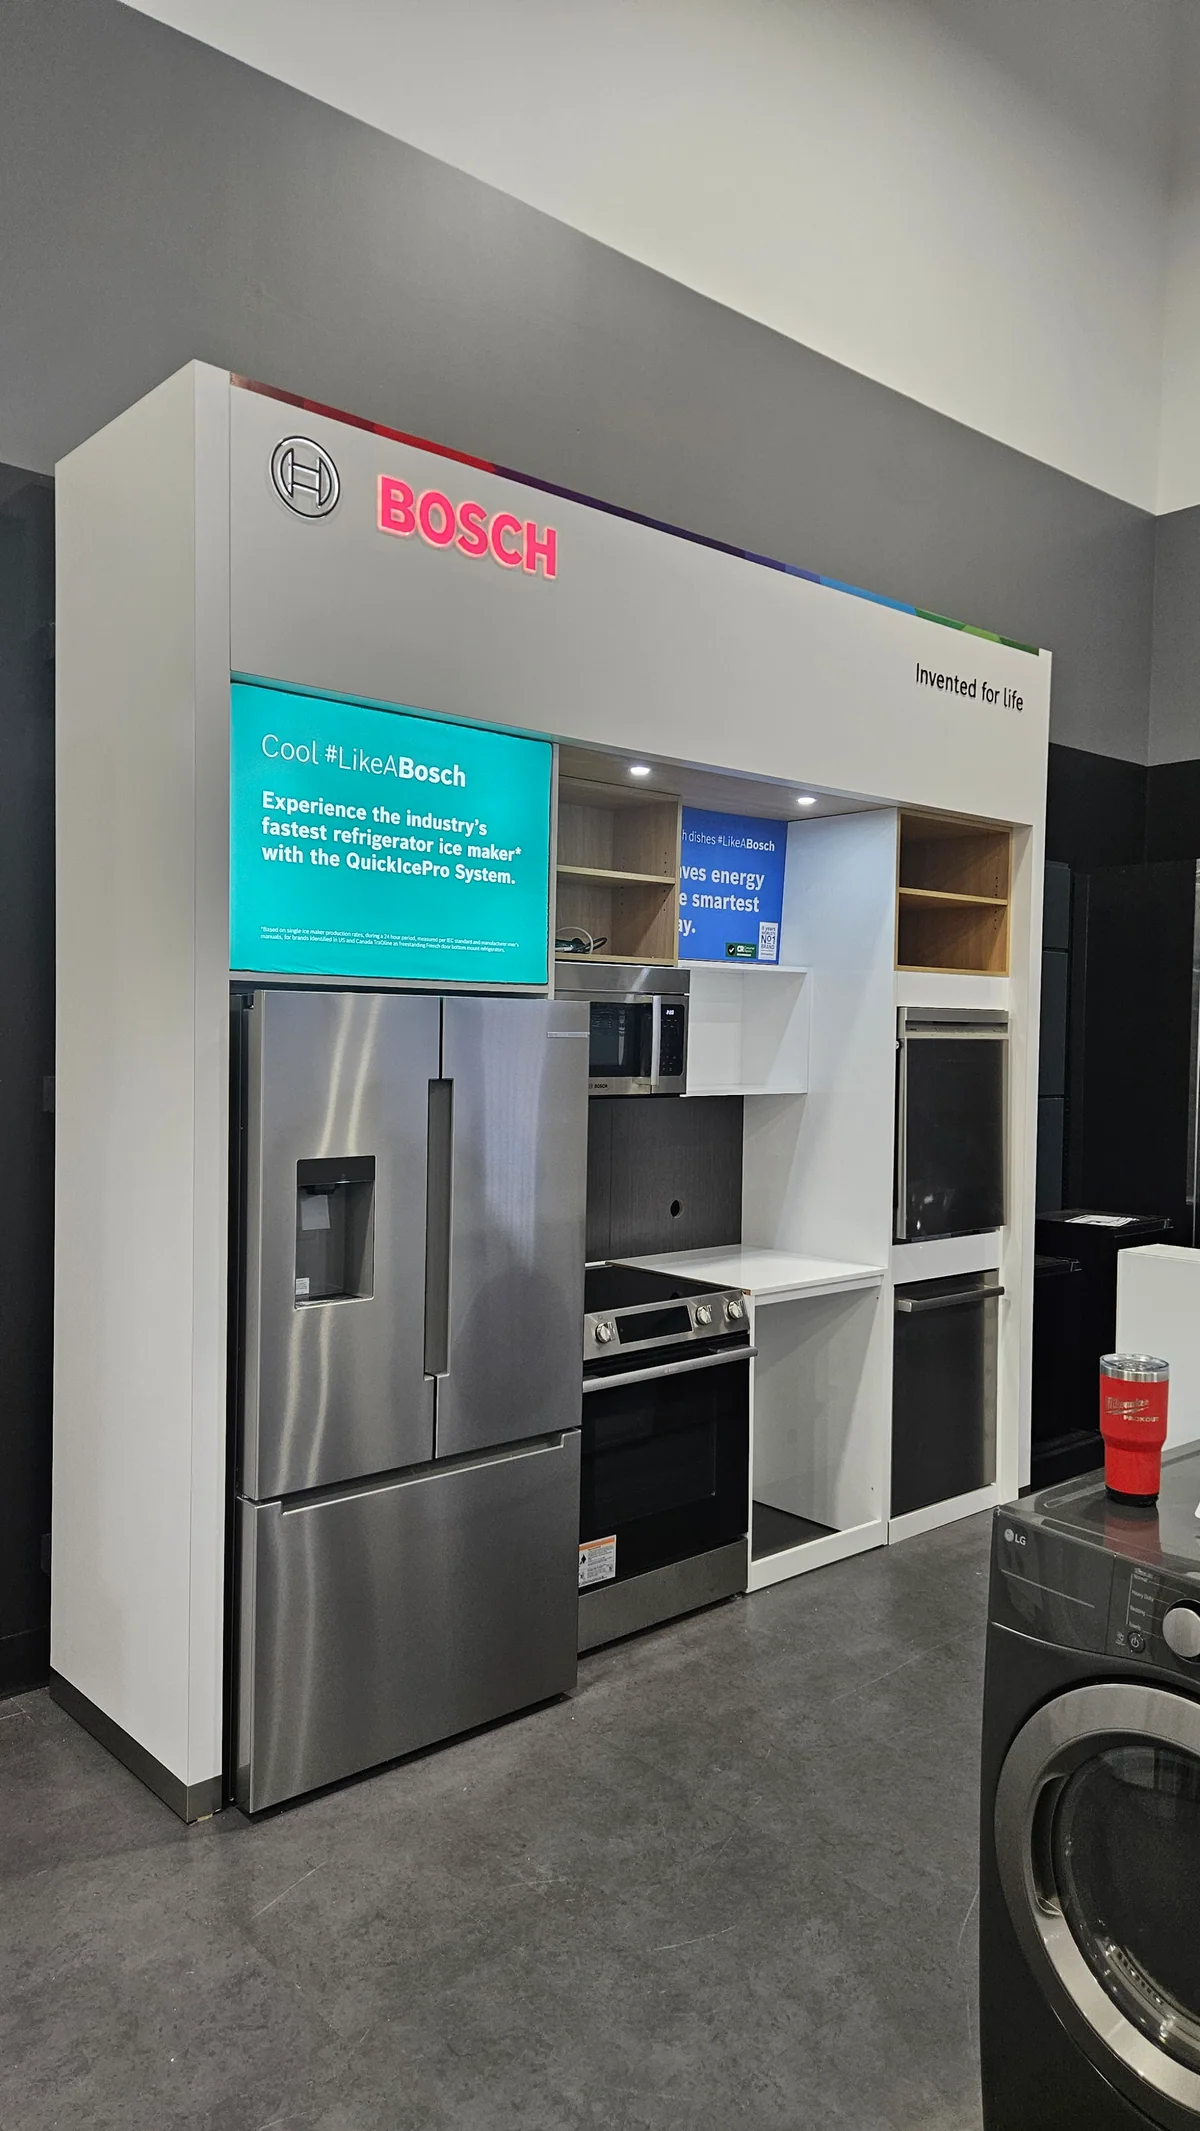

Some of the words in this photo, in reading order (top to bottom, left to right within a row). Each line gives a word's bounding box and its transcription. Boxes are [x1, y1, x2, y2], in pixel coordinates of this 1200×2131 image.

[377, 474, 558, 581] BOSCH
[916, 662, 977, 698] Invented
[981, 682, 1000, 704] for
[1003, 687, 1024, 711] life
[261, 733, 318, 765] Cool
[324, 743, 466, 788] #LikeABosch
[262, 790, 367, 821] Experience
[372, 805, 401, 825] the
[406, 809, 488, 837] industry's
[261, 816, 327, 841] fastest
[333, 826, 434, 853] refrigerator
[438, 837, 462, 856] ice
[689, 831, 716, 846] dishes
[717, 836, 775, 852] #LikeABosch
[261, 843, 304, 864] with
[309, 847, 340, 867] the
[346, 851, 450, 879] QuickIcePro
[454, 863, 516, 885] System.
[680, 865, 706, 882] ves
[711, 870, 765, 891] energy
[692, 893, 760, 913] smartest
[286, 926, 301, 936] single
[310, 928, 325, 936] maker
[325, 930, 351, 938] production
[292, 934, 309, 942] brands
[338, 936, 346, 944] US
[346, 937, 355, 945] and
[355, 938, 373, 946] Canada
[1014, 1533, 1027, 1546] LG
